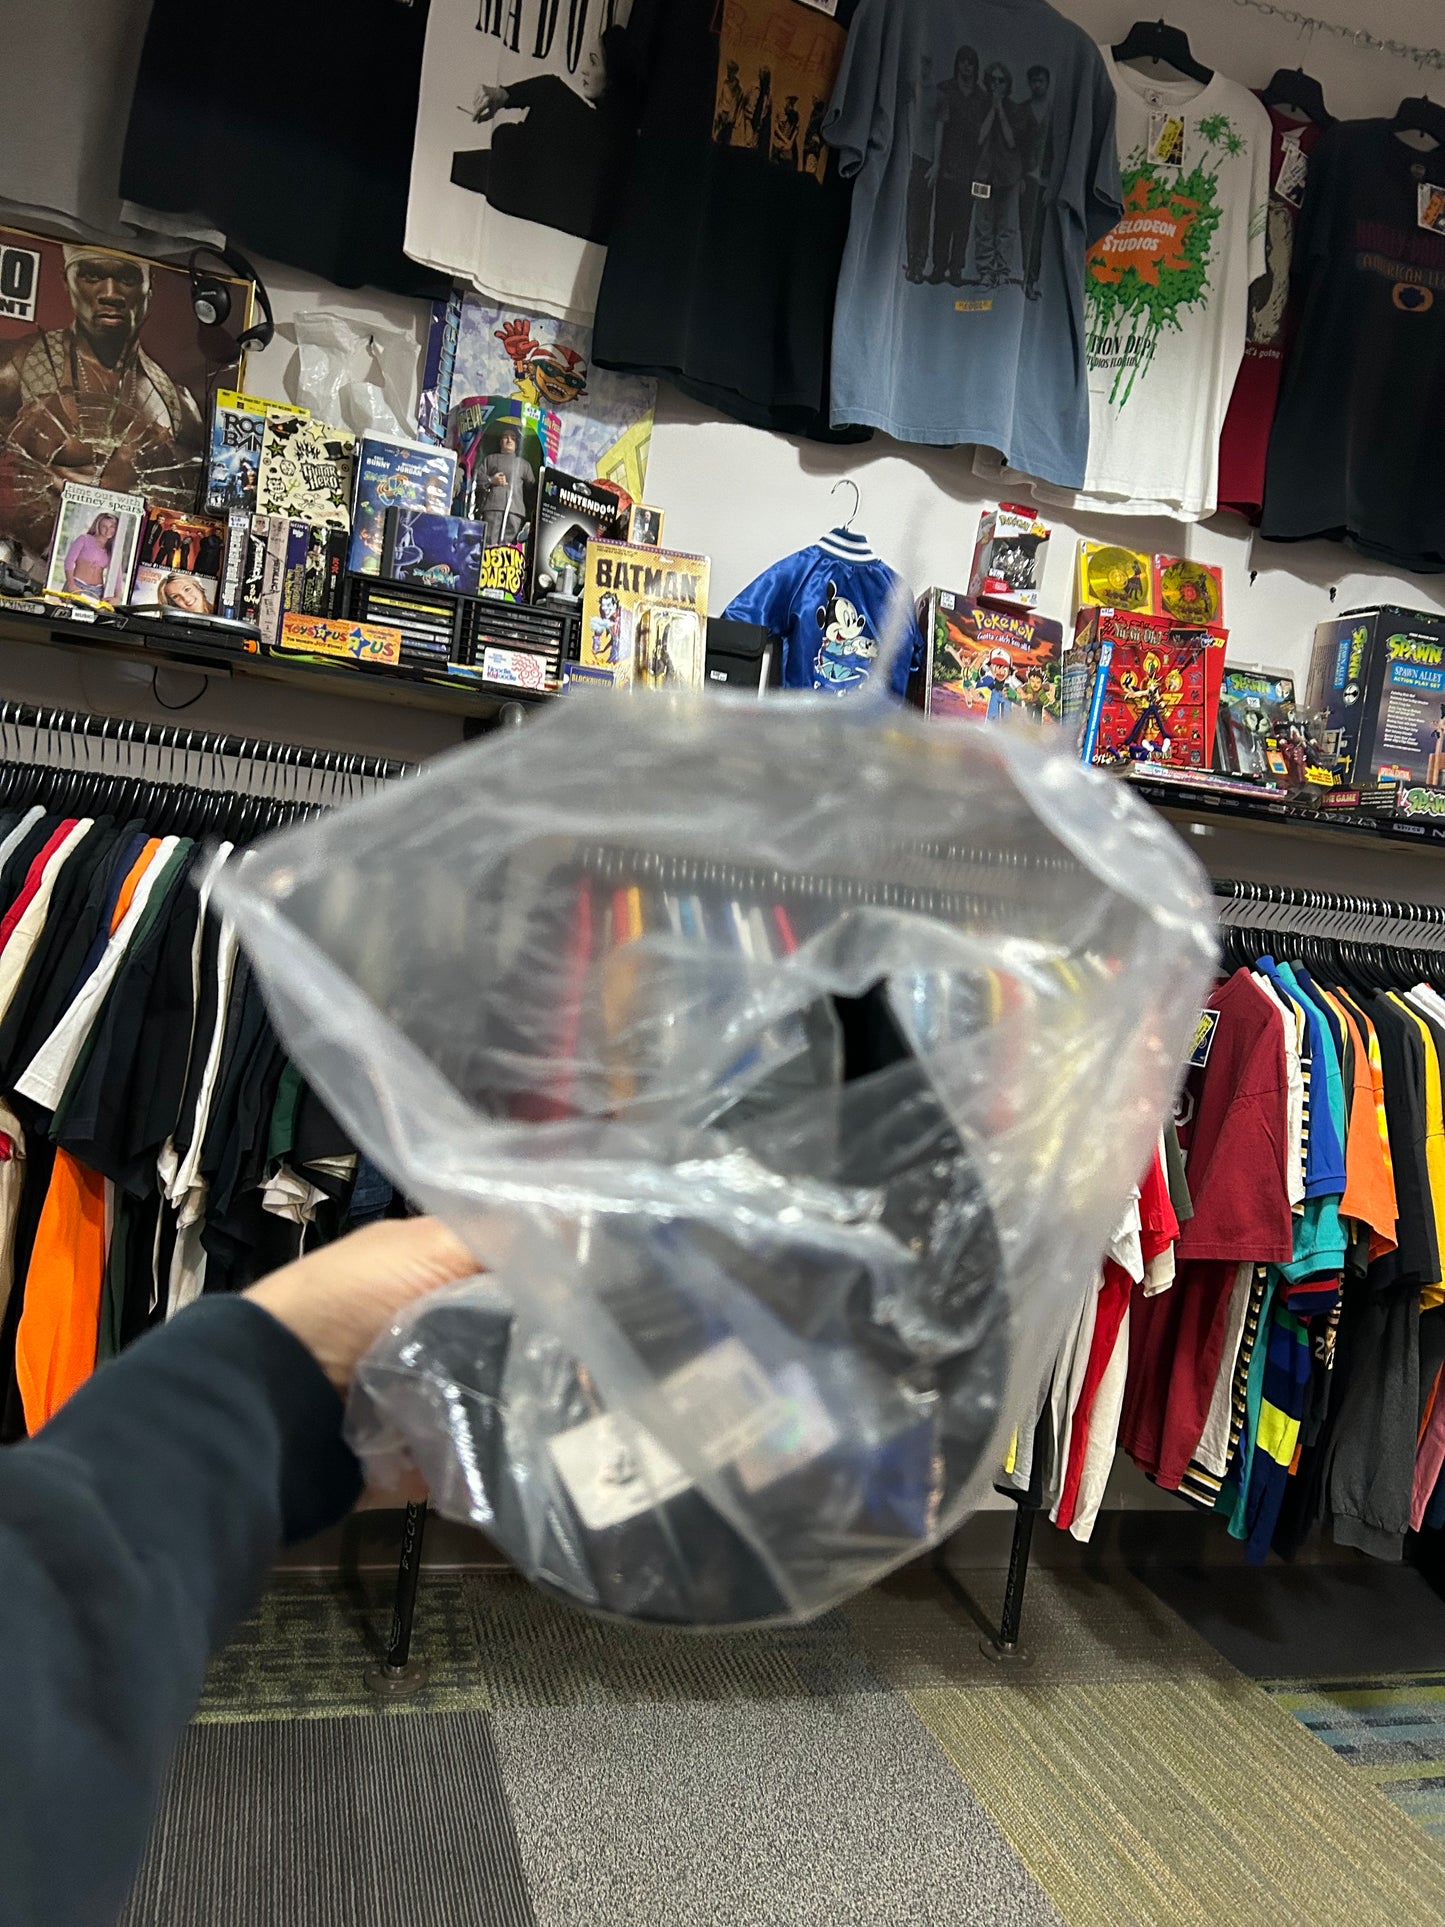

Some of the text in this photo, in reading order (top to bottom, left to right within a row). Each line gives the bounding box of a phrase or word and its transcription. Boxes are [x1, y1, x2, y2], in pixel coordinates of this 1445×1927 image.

[1086, 332, 1123, 356] TION
[366, 458, 391, 470] BUNNY
[64, 490, 143, 514] britney spears
[596, 558, 698, 604] BATMAN
[285, 623, 315, 636] TOYS
[331, 631, 348, 642] US
[1386, 633, 1444, 665] SPAWN
[1393, 675, 1414, 685] ACTION
[1394, 665, 1443, 683] SPAWN ALLEY
